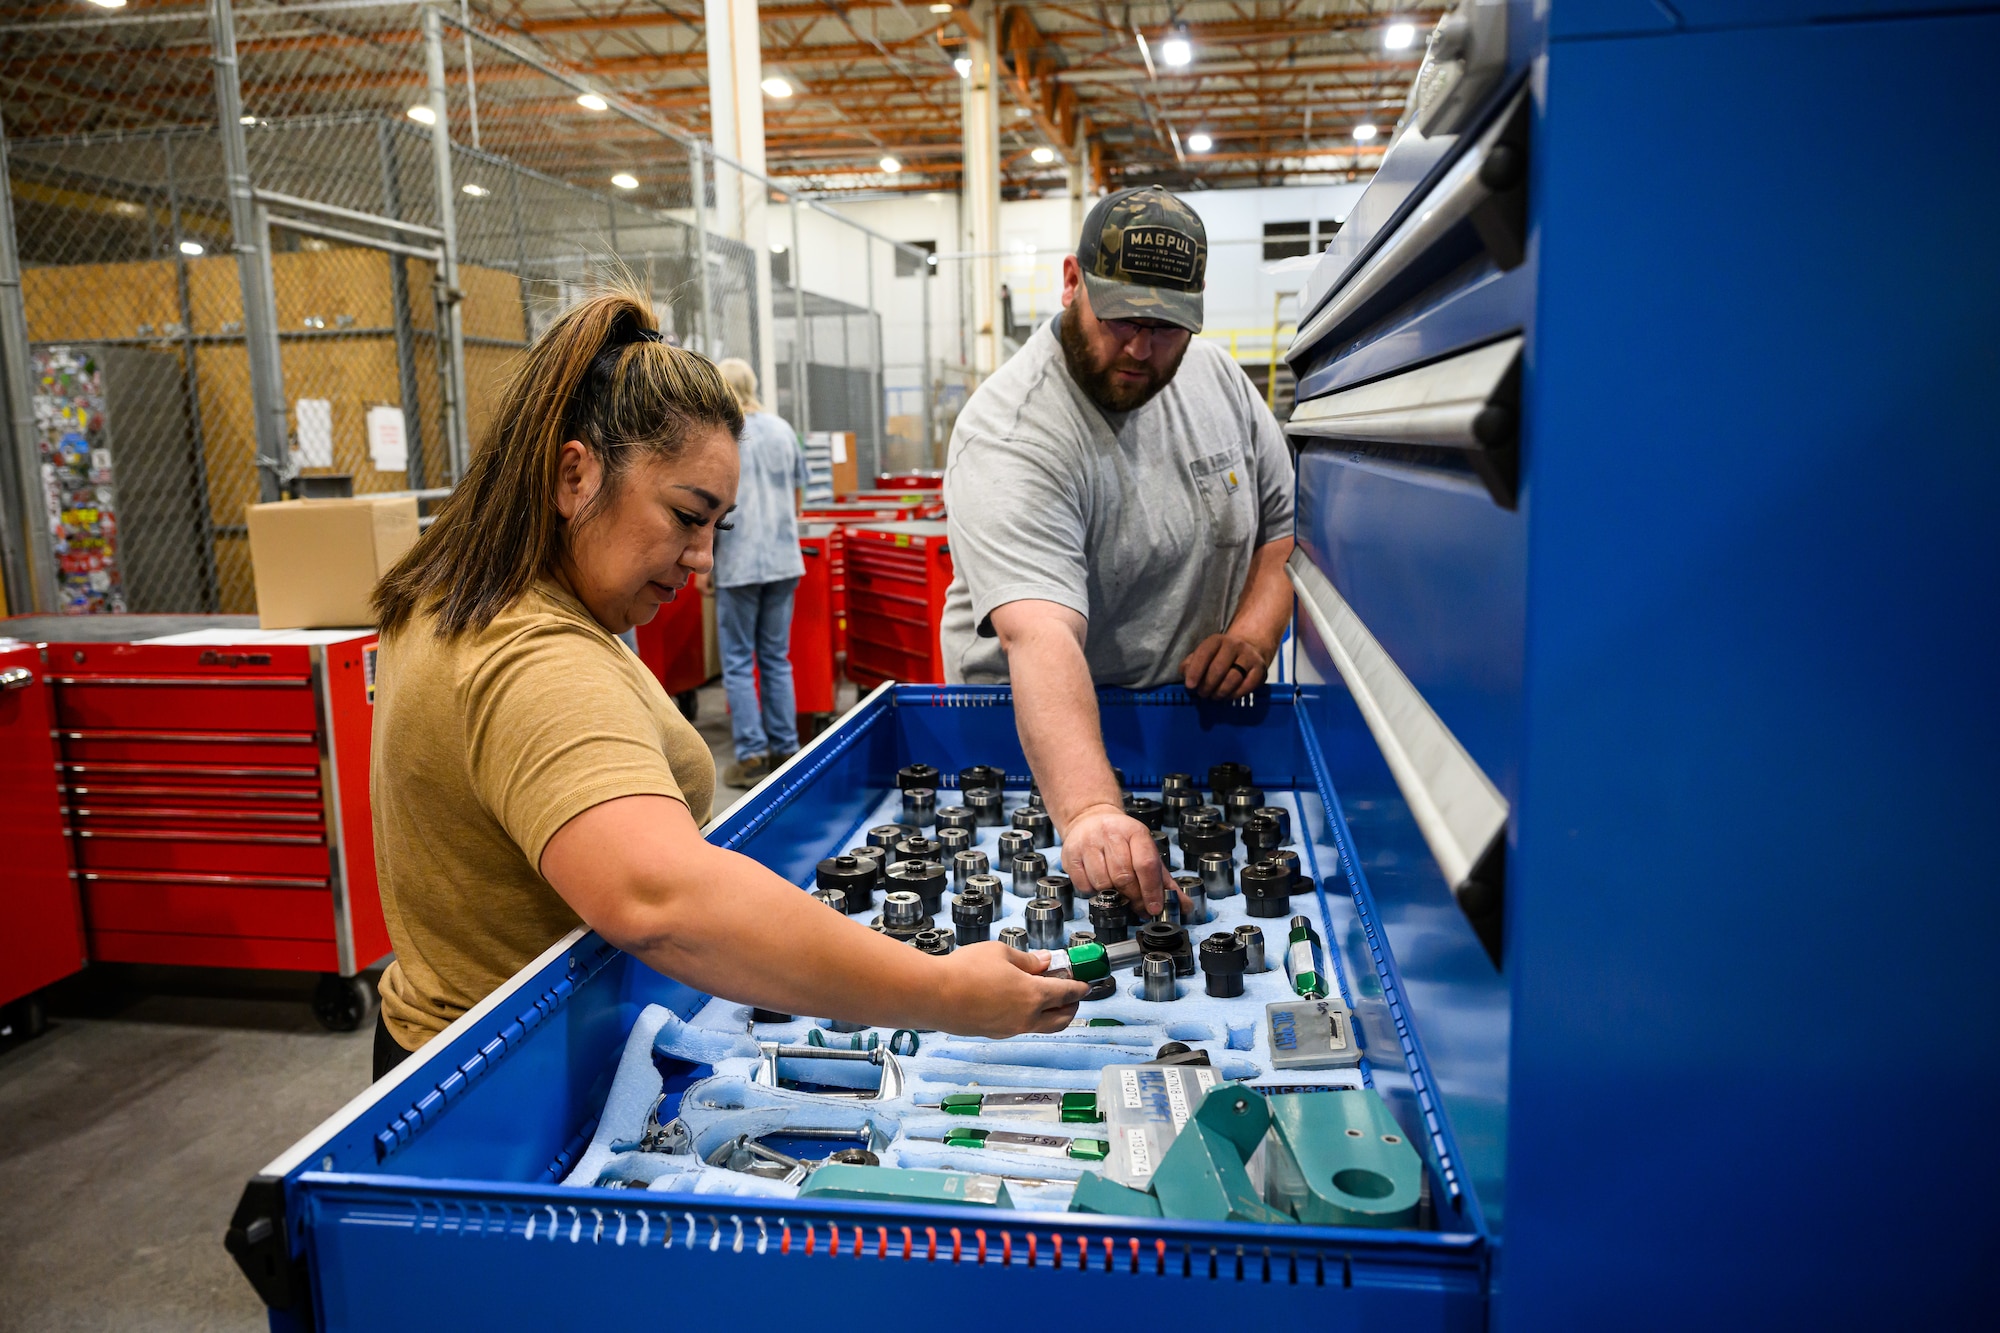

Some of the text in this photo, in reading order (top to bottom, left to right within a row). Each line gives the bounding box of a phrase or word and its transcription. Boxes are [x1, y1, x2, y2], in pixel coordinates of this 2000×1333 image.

[1130, 232, 1191, 255] MAGPUL
[1126, 1087, 1138, 1101] QTY
[1133, 1148, 1147, 1165] QTY
